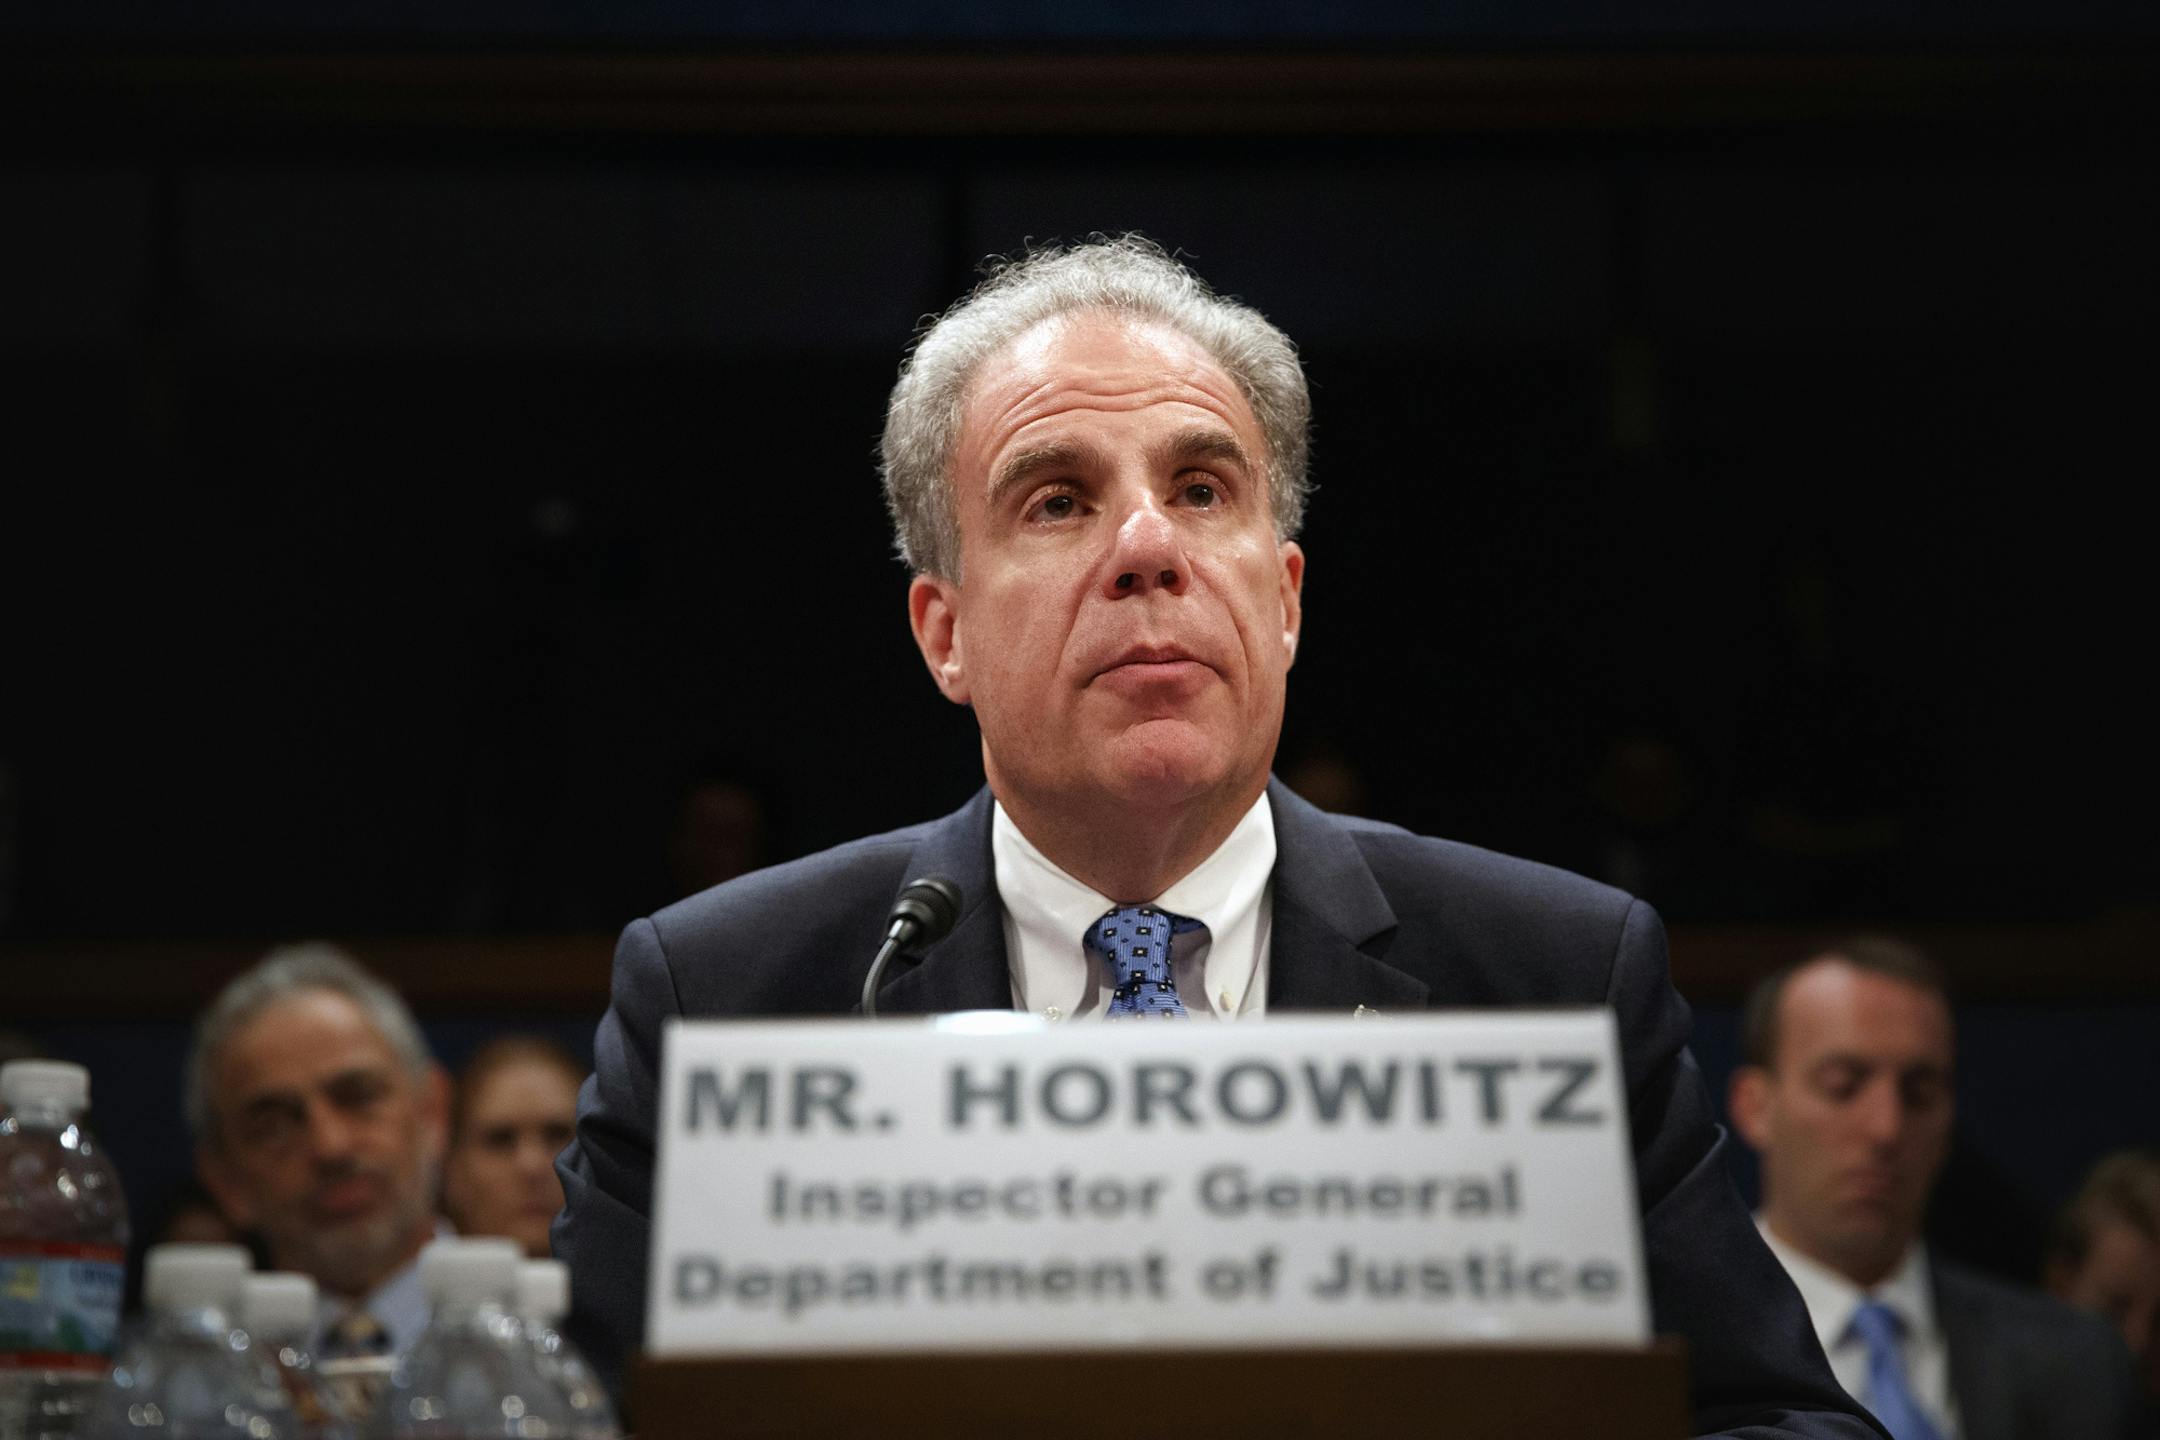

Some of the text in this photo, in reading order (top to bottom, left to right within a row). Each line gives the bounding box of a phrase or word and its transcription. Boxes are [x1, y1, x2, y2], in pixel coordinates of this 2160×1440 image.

[684, 1057, 1608, 1134] MR. HOROWITZ
[769, 1163, 1521, 1233] Inspector General
[674, 1244, 1620, 1319] Department of Justice
